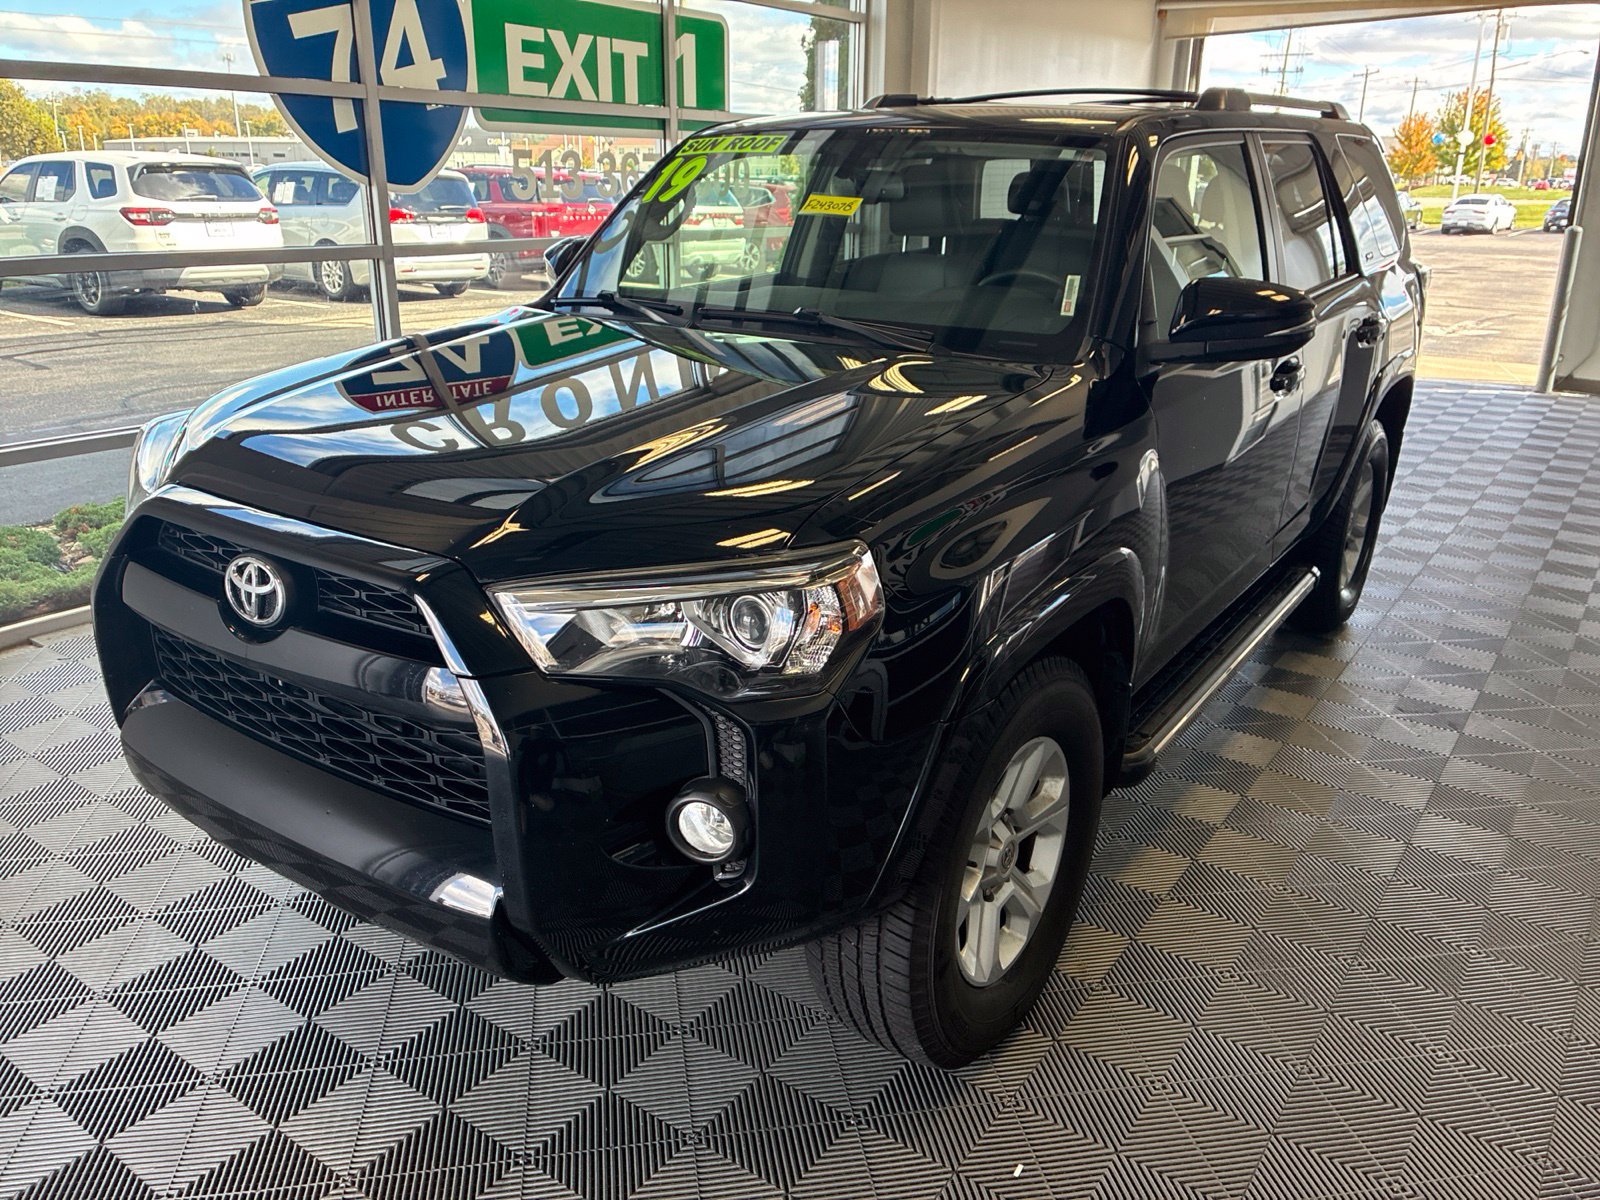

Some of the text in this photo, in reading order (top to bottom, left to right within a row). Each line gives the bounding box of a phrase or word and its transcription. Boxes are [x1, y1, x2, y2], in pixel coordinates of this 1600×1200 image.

[286, 0, 448, 134] 74
[504, 21, 698, 108] EXIT 1
[680, 136, 784, 153] SUN ROOF
[510, 149, 584, 201] 513
[596, 151, 660, 198] 36
[641, 155, 708, 204] 19
